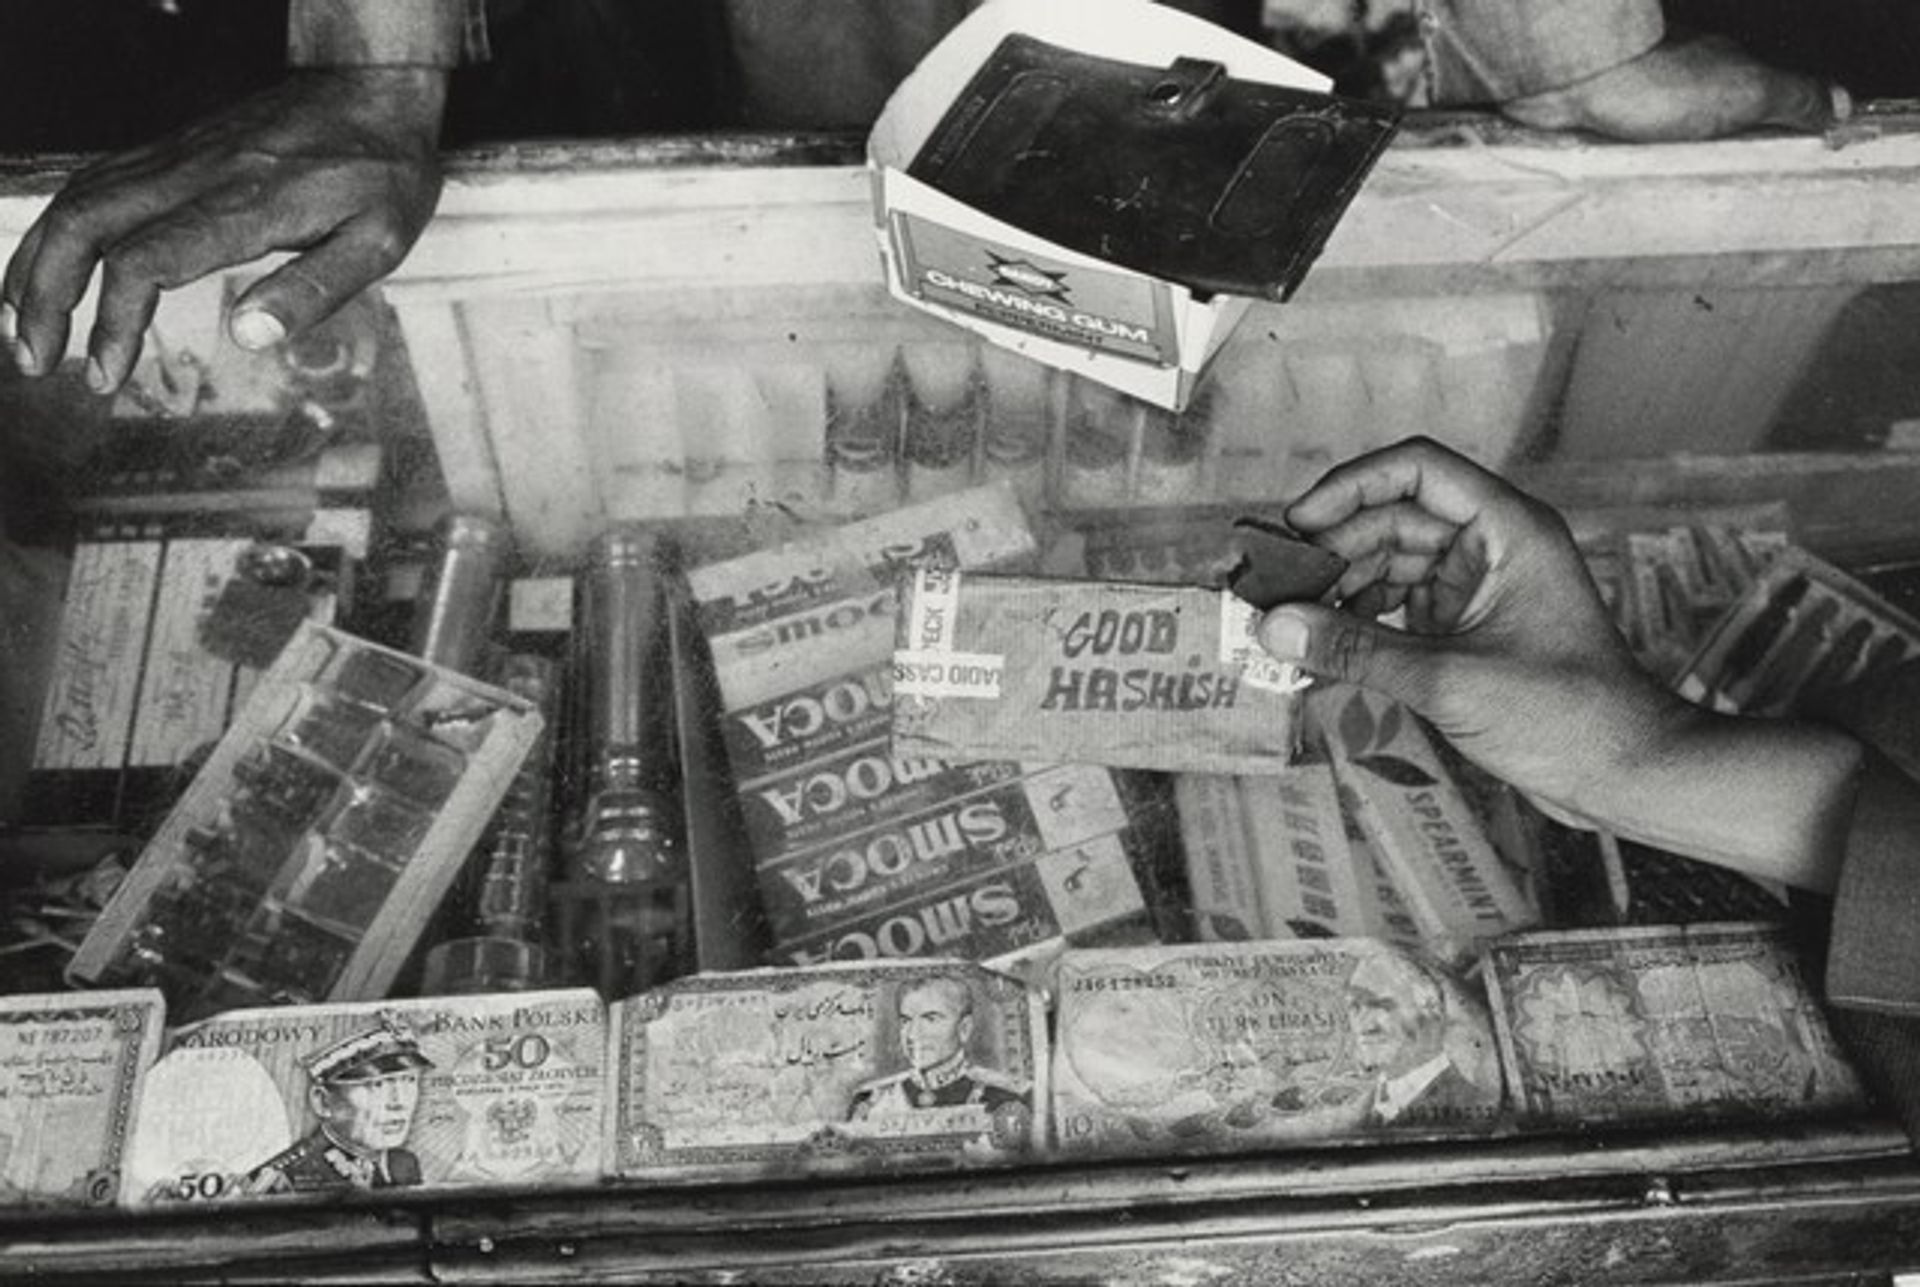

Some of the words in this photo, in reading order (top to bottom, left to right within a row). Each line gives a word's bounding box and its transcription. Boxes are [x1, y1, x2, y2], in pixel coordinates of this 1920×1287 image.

[925, 269, 1067, 324] CHEWING
[1072, 313, 1149, 343] GUM
[1062, 608, 1178, 658] GOOD
[1405, 791, 1505, 920] SPEARMINT
[184, 1024, 318, 1049] ARODOWY
[434, 1011, 501, 1034] BANK
[513, 1007, 599, 1029] POLSKI
[481, 1033, 551, 1071] 50
[178, 1172, 224, 1200] 50
